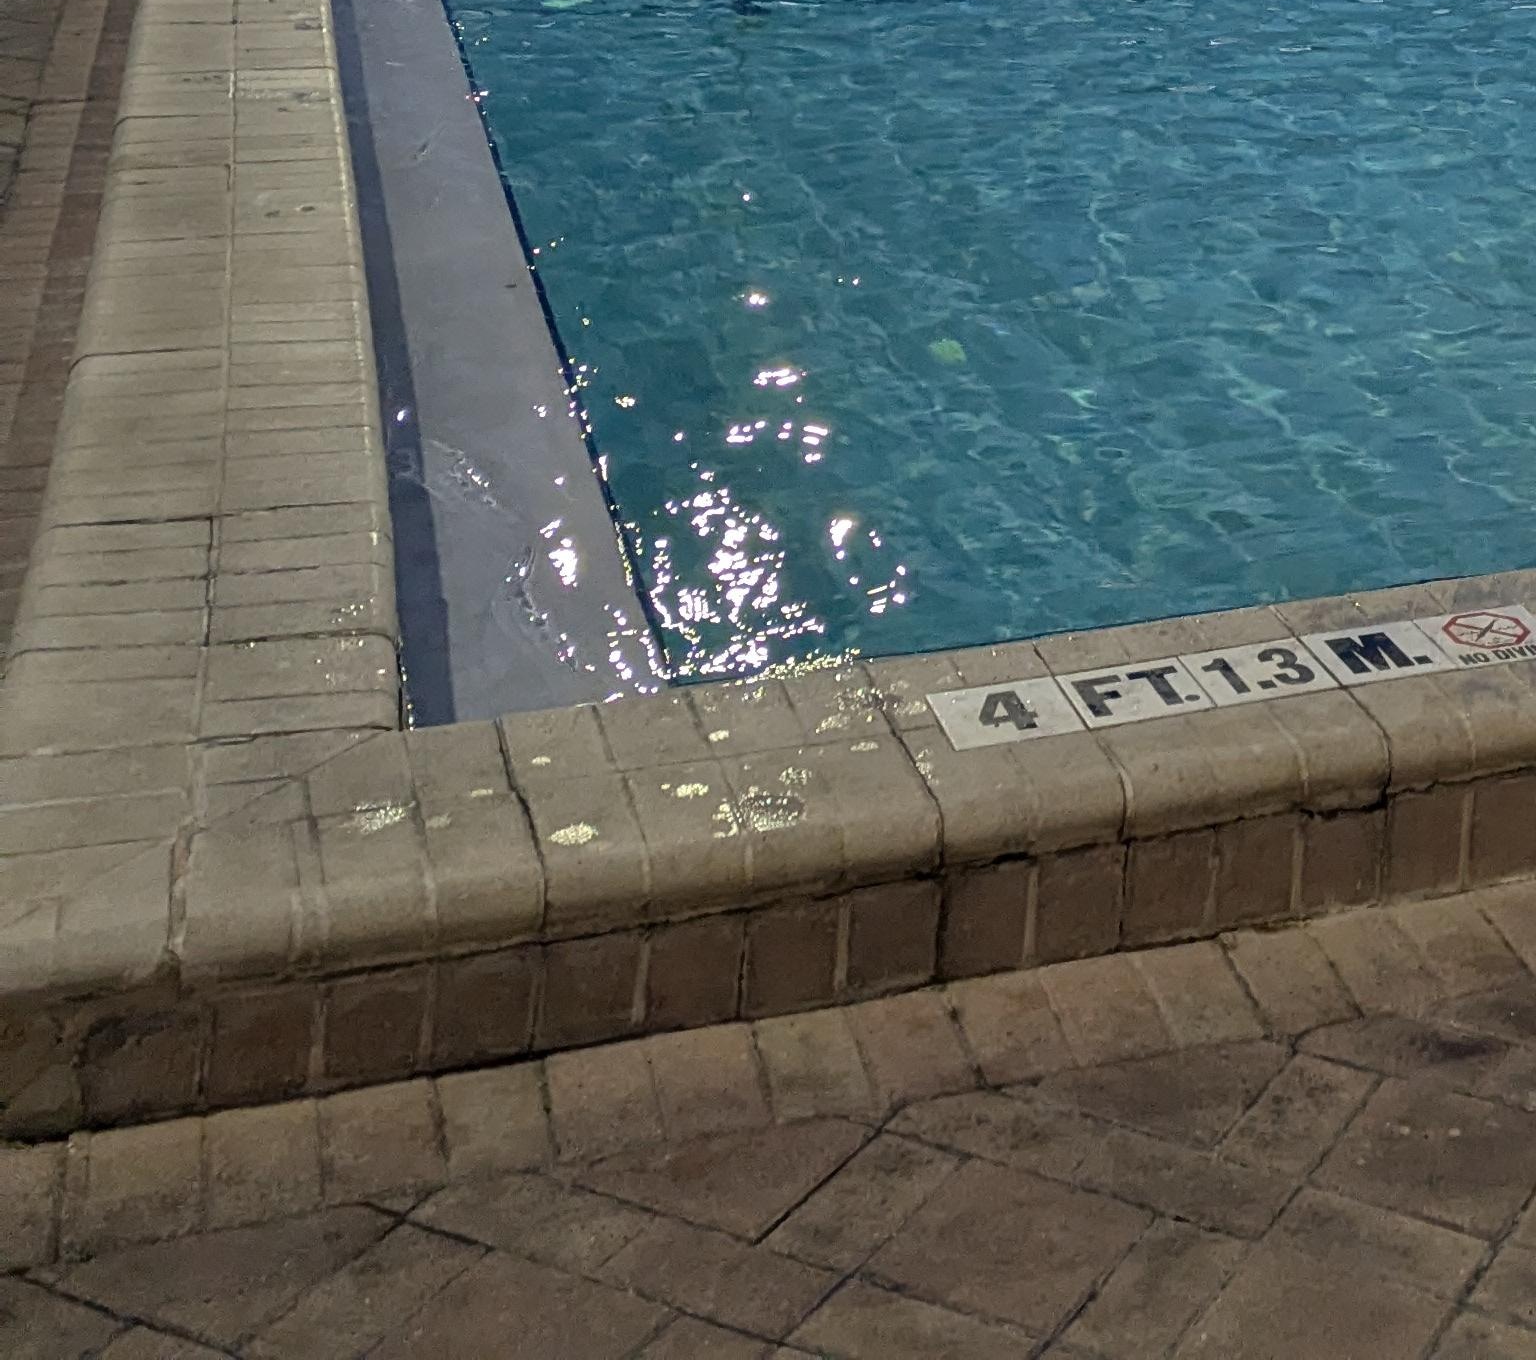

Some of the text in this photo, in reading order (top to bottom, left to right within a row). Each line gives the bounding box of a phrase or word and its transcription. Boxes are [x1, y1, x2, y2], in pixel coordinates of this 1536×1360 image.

[978, 631, 1434, 731] 4 FT. 1.3 M.
[1458, 652, 1491, 666] NO
